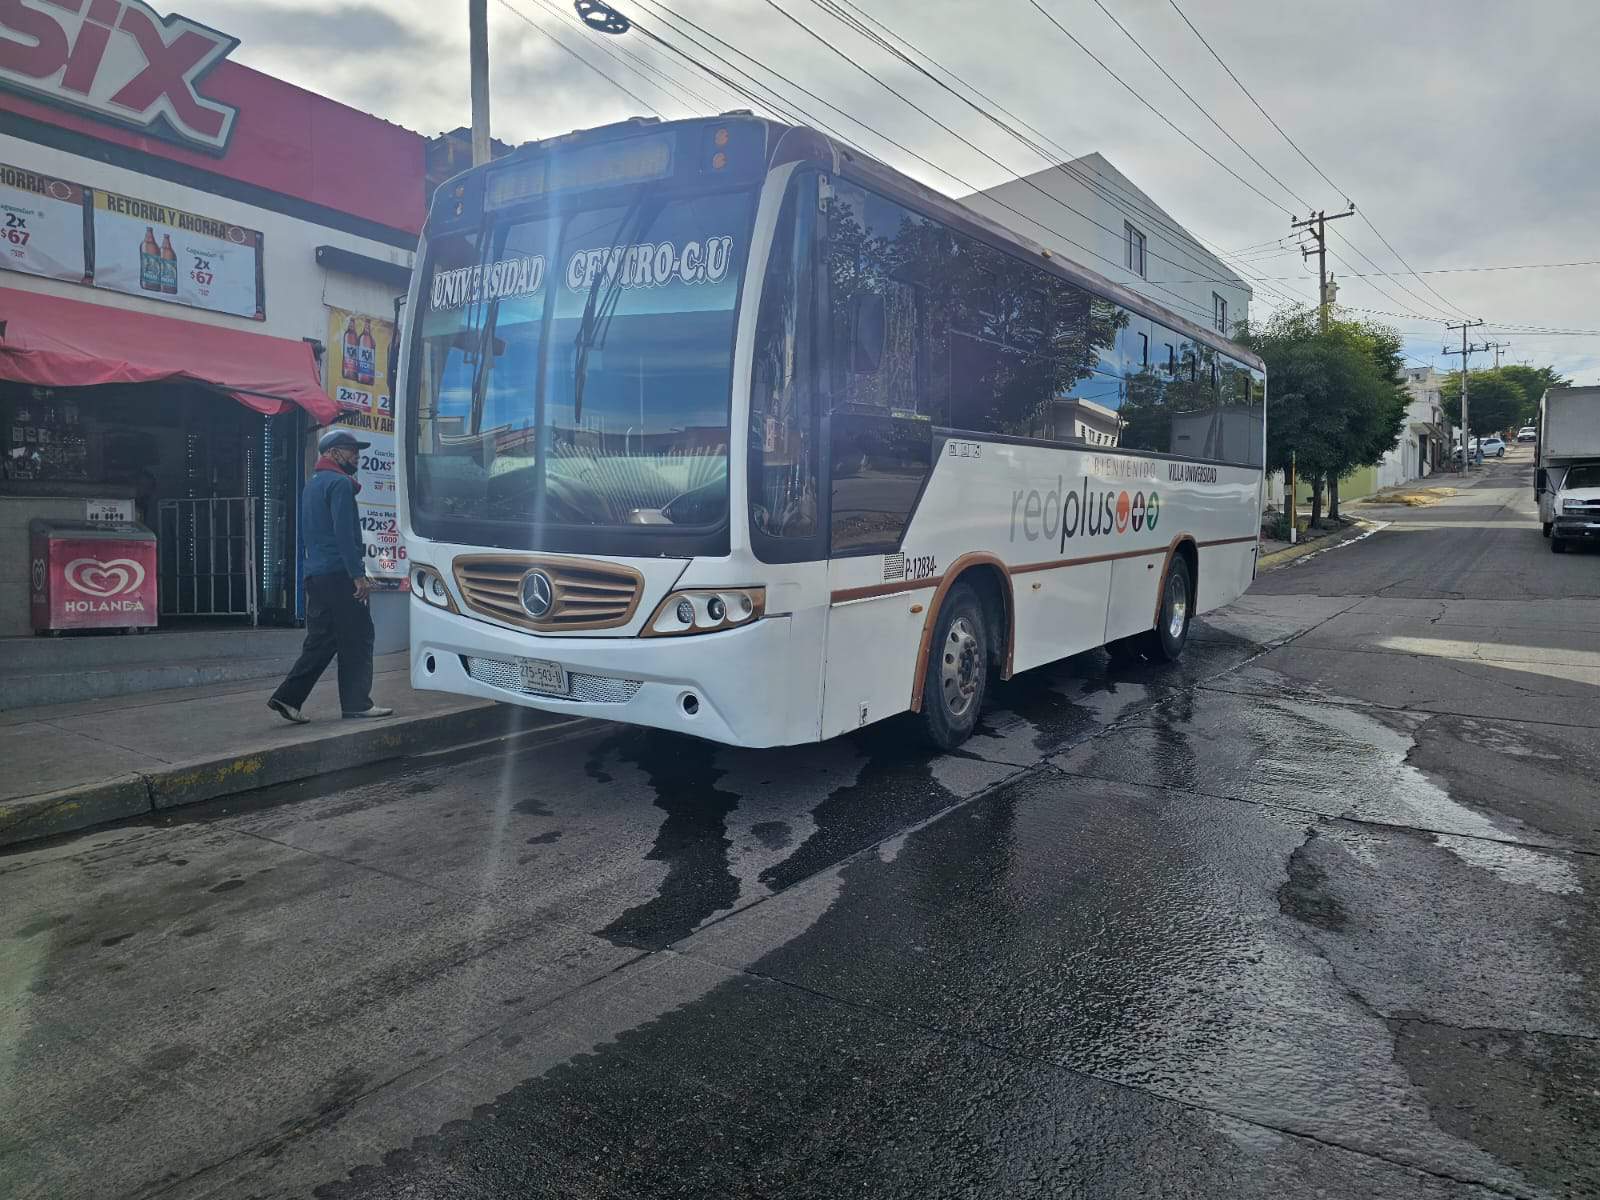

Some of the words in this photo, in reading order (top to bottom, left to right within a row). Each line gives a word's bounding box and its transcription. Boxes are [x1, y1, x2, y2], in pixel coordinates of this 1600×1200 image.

[6, 212, 27, 229] 2x
[107, 194, 166, 224] RETORNA
[168, 209, 177, 226] Y
[178, 213, 226, 239] AHORRA
[0, 227, 30, 246] $67
[194, 256, 210, 270] 2x
[190, 269, 214, 286] $67
[432, 256, 545, 310] UNIVERSIDAD
[373, 415, 380, 430] Y
[1094, 457, 1156, 479] BIENVENIDO
[1168, 463, 1184, 482] VILLA
[1184, 464, 1217, 484] UNIVERSIDAD
[1010, 474, 1115, 554] redplus
[65, 600, 145, 612] HOLANDA
